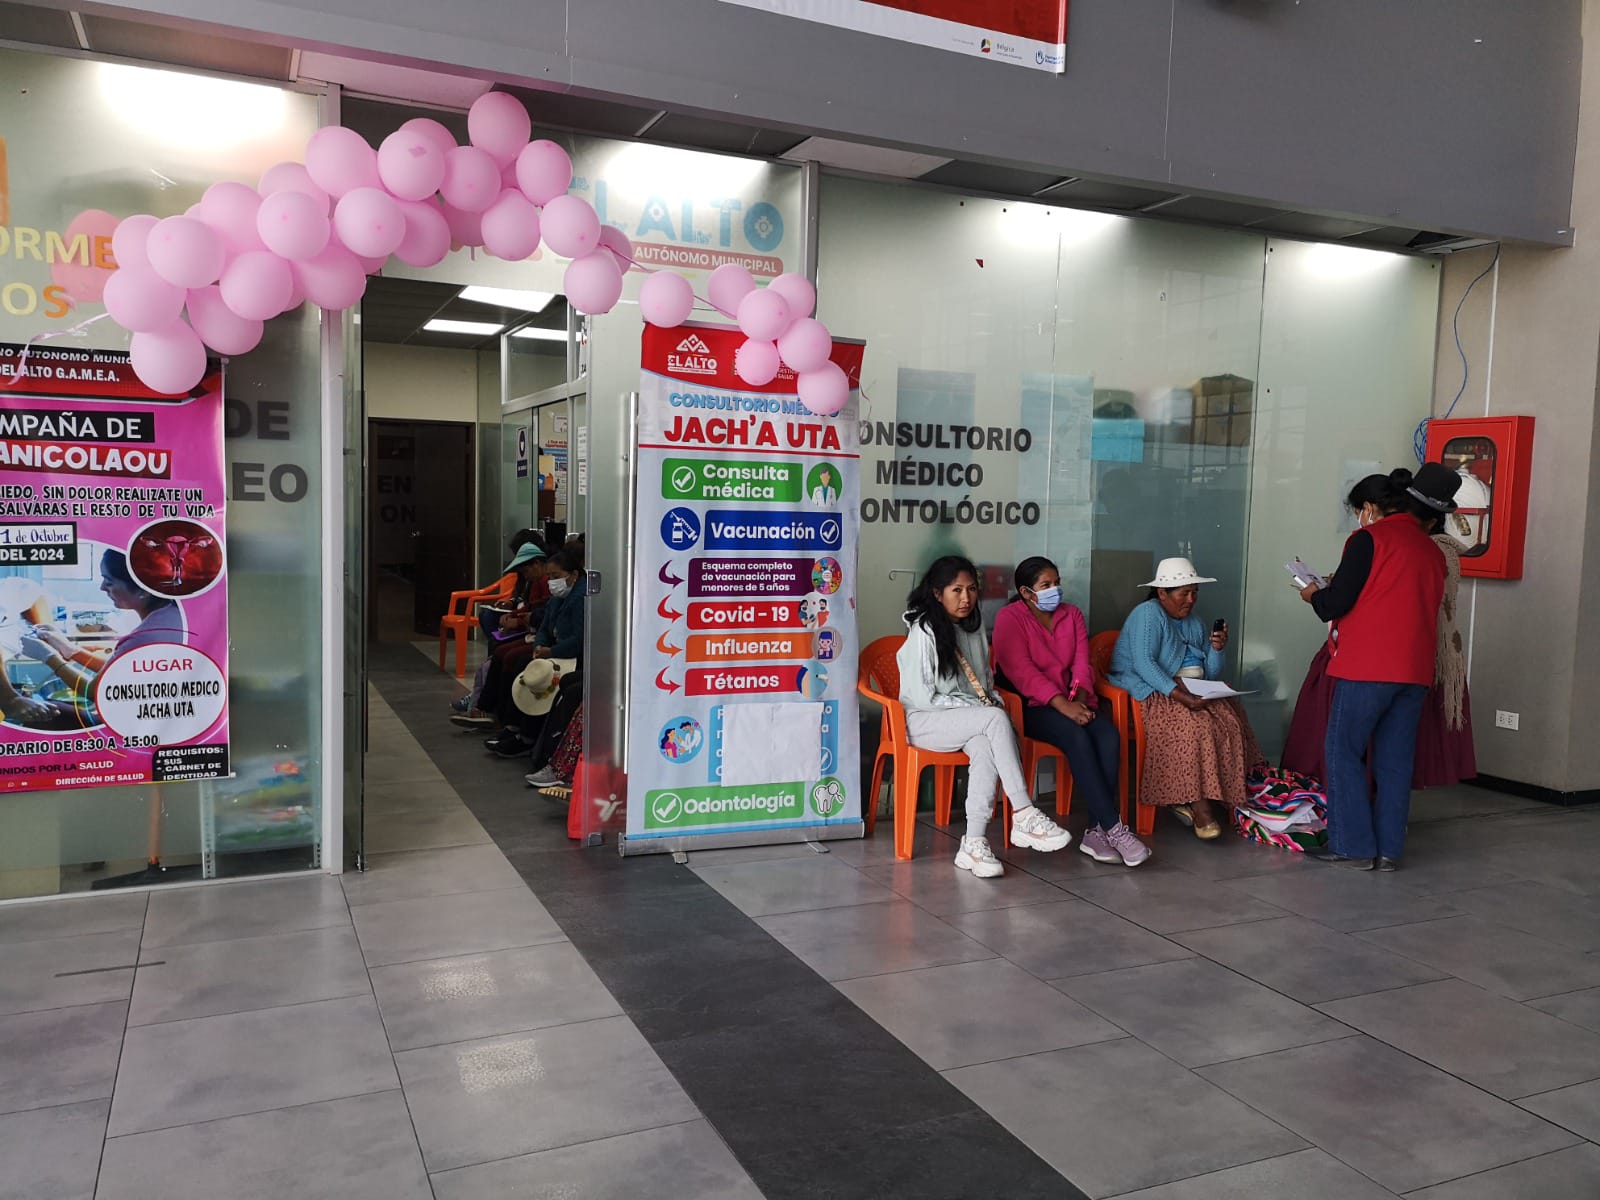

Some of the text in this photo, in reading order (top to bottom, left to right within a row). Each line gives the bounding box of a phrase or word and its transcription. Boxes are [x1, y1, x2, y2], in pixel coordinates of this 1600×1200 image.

[634, 245, 777, 274] AUTÓNOMO MUNICIPAL
[668, 354, 718, 370] EL ALTO
[22, 366, 53, 378] ALTO
[55, 367, 120, 382] G.A.M.E.A.
[669, 392, 781, 413] CONSULTORIO
[106, 417, 142, 439] DE
[786, 422, 841, 450] UTA
[702, 463, 790, 481] Consulta
[876, 455, 984, 487] MÉDICO
[0, 485, 203, 501] IEDO, SIN DOLOR REALIZATE UN
[702, 483, 775, 499] médica
[0, 502, 215, 517] SALVARAS EL RESTO DE TU VIDA
[859, 494, 1041, 525] ONTOLÓGICO
[15, 529, 27, 543] de
[30, 528, 70, 543] Octubre
[710, 521, 816, 540] Vacunación
[0, 548, 65, 561] DEL 2024
[702, 561, 793, 573] Esquema completo
[701, 571, 796, 582] de vacunación para
[701, 582, 790, 592] menores de 5 años
[700, 606, 755, 623] Covid
[771, 606, 790, 622] 19
[705, 638, 792, 656] Influenza
[132, 658, 193, 673] LUGAR
[703, 672, 780, 690] Tétanos
[105, 680, 220, 701] CONSULTORIO MEDICO
[136, 700, 194, 719] JACHA UTA
[53, 740, 72, 753] DE
[75, 738, 104, 751] 8:30
[107, 737, 116, 749] A
[123, 735, 159, 748] 15:00
[158, 747, 224, 757] REQUISITOS:
[0, 760, 114, 775] NIDOS POR LA SALUD
[163, 758, 183, 766] SUS
[207, 762, 222, 770] DE
[55, 774, 103, 786] DIRECCIÓN
[117, 773, 145, 781] SALUD
[163, 771, 218, 781] IDENTIDAD
[683, 792, 796, 814] Odontología
